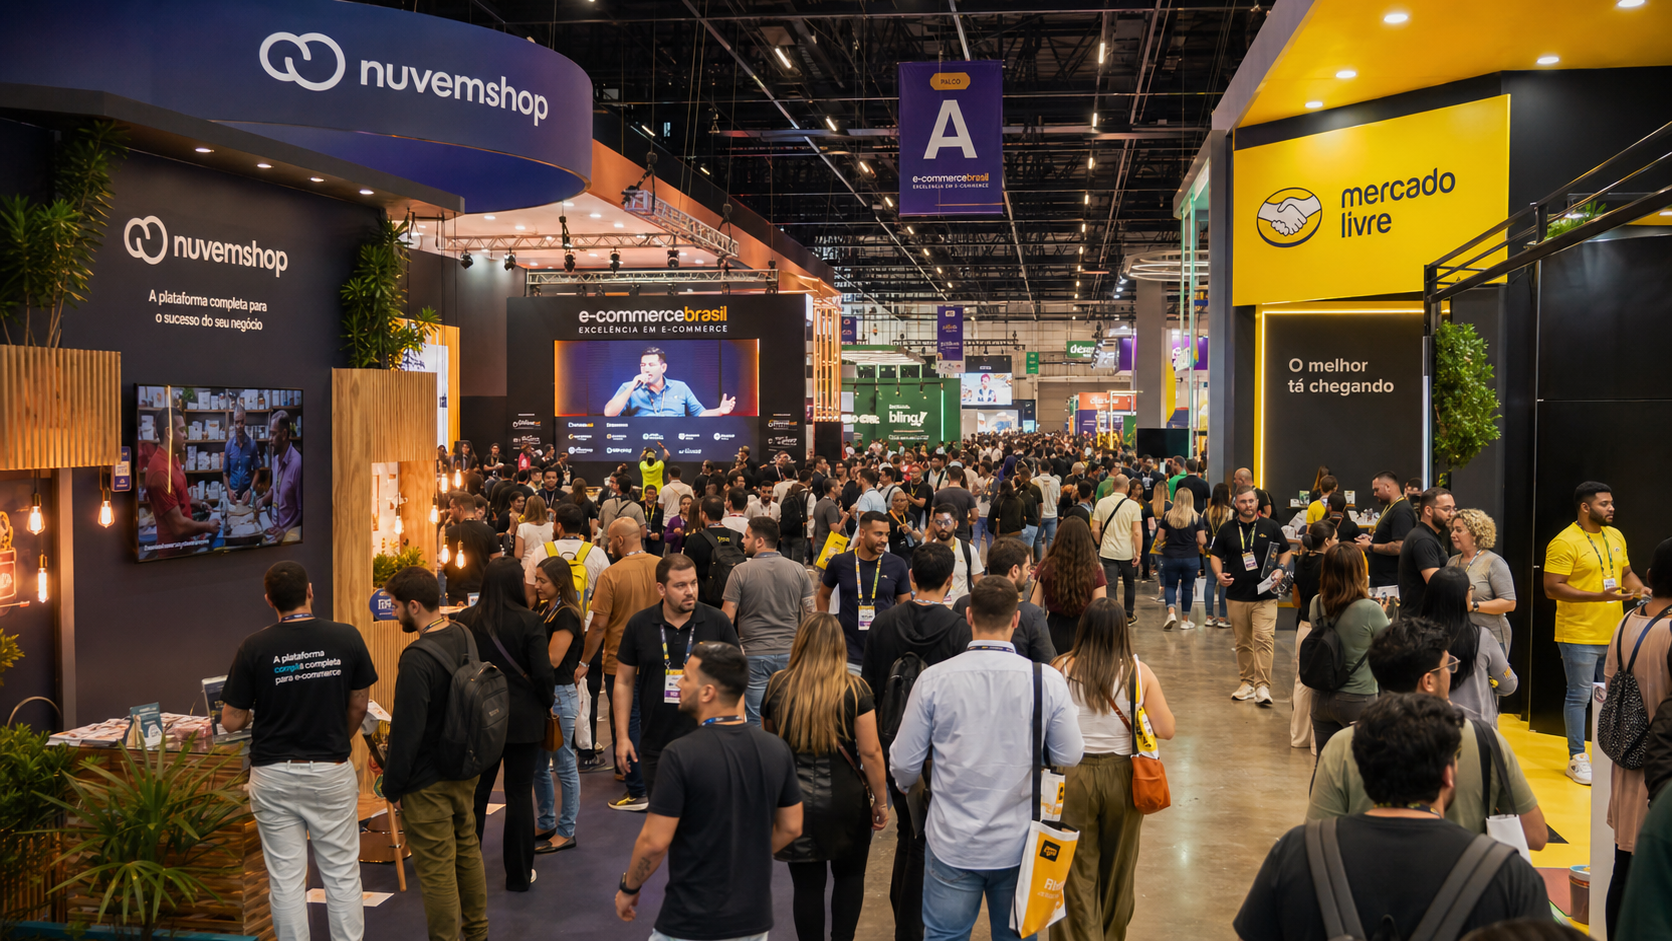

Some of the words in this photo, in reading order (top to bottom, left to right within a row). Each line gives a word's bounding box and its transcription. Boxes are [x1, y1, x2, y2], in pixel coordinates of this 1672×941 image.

[360, 59, 549, 127] nuvemshop
[922, 99, 978, 160] A
[912, 172, 989, 183] e-commercebrasil
[1341, 167, 1456, 209] mercado
[1341, 211, 1392, 238] livre
[173, 235, 289, 278] nuvemshop
[148, 289, 157, 302] A
[158, 290, 208, 306] plataforma
[209, 297, 248, 311] completa
[249, 300, 267, 313] para
[155, 313, 162, 323] o
[163, 313, 200, 327] sucesso
[201, 314, 213, 327] do
[214, 317, 230, 329] seu
[231, 317, 263, 331] negócio
[578, 305, 728, 323] e-commercebrasil
[578, 324, 639, 334] EXCELÊNCIA
[643, 325, 656, 333] EM
[661, 324, 728, 333] E-COMMERCE
[1288, 358, 1304, 373] O
[1308, 358, 1369, 373] melhor
[1287, 378, 1304, 393] tá
[1309, 378, 1395, 397] chegando
[273, 655, 280, 663] A
[281, 650, 324, 663] plataforma
[304, 658, 341, 668] completa
[275, 675, 293, 685] para
[294, 669, 341, 680] e-commerce
